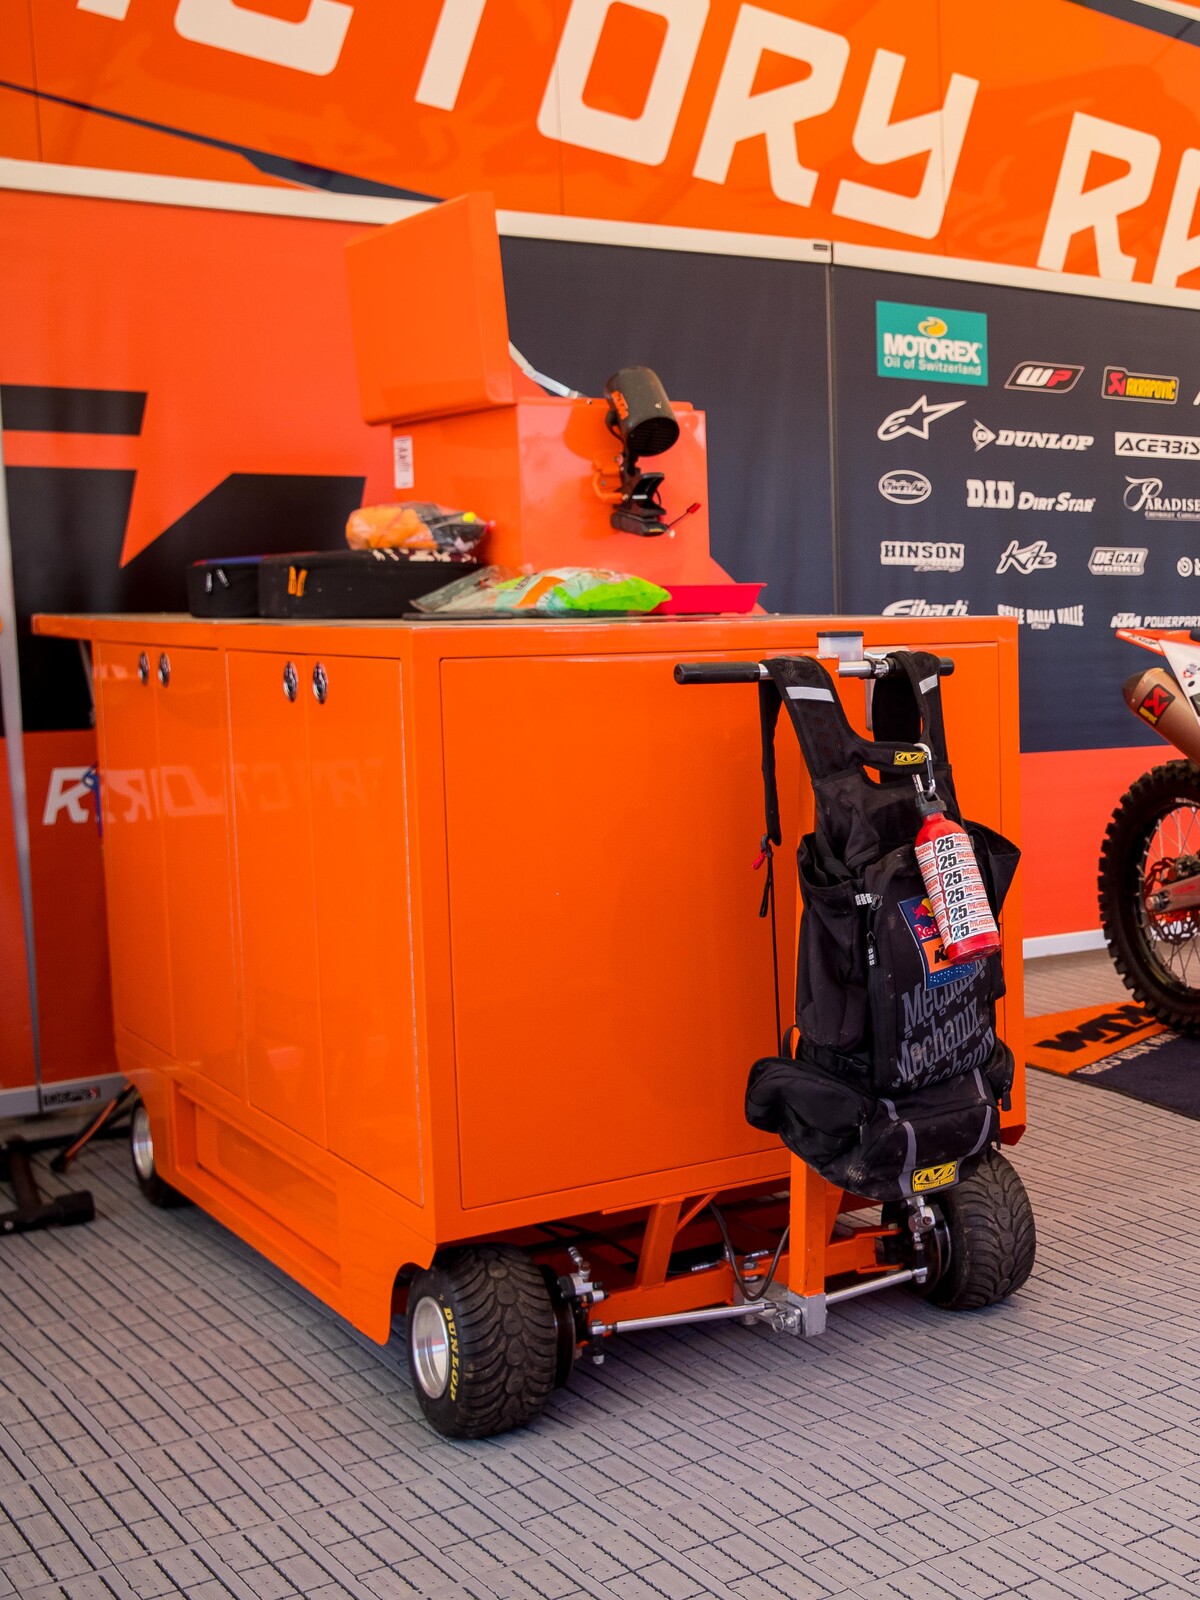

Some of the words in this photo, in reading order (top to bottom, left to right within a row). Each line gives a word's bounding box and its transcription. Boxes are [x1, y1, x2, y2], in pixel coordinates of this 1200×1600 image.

[883, 333, 981, 364] MOTOREX
[884, 355, 901, 368] Oil
[903, 357, 916, 369] of
[918, 359, 981, 377] Switzerland
[1016, 366, 1073, 387] WP
[995, 429, 1094, 452] DUNLOP
[884, 544, 962, 559] HINSON
[1093, 550, 1142, 566] DECAL
[1026, 609, 1055, 624] DALLA
[1057, 604, 1084, 626] VALLE
[1110, 612, 1142, 629] KTM
[936, 836, 954, 854] 25
[940, 853, 957, 872] 25
[944, 869, 961, 889] 25
[947, 886, 965, 906] 25
[950, 904, 968, 923] 25
[953, 922, 970, 941] 25
[1033, 1005, 1158, 1052] KTM
[443, 1307, 460, 1401] DUNLOP
